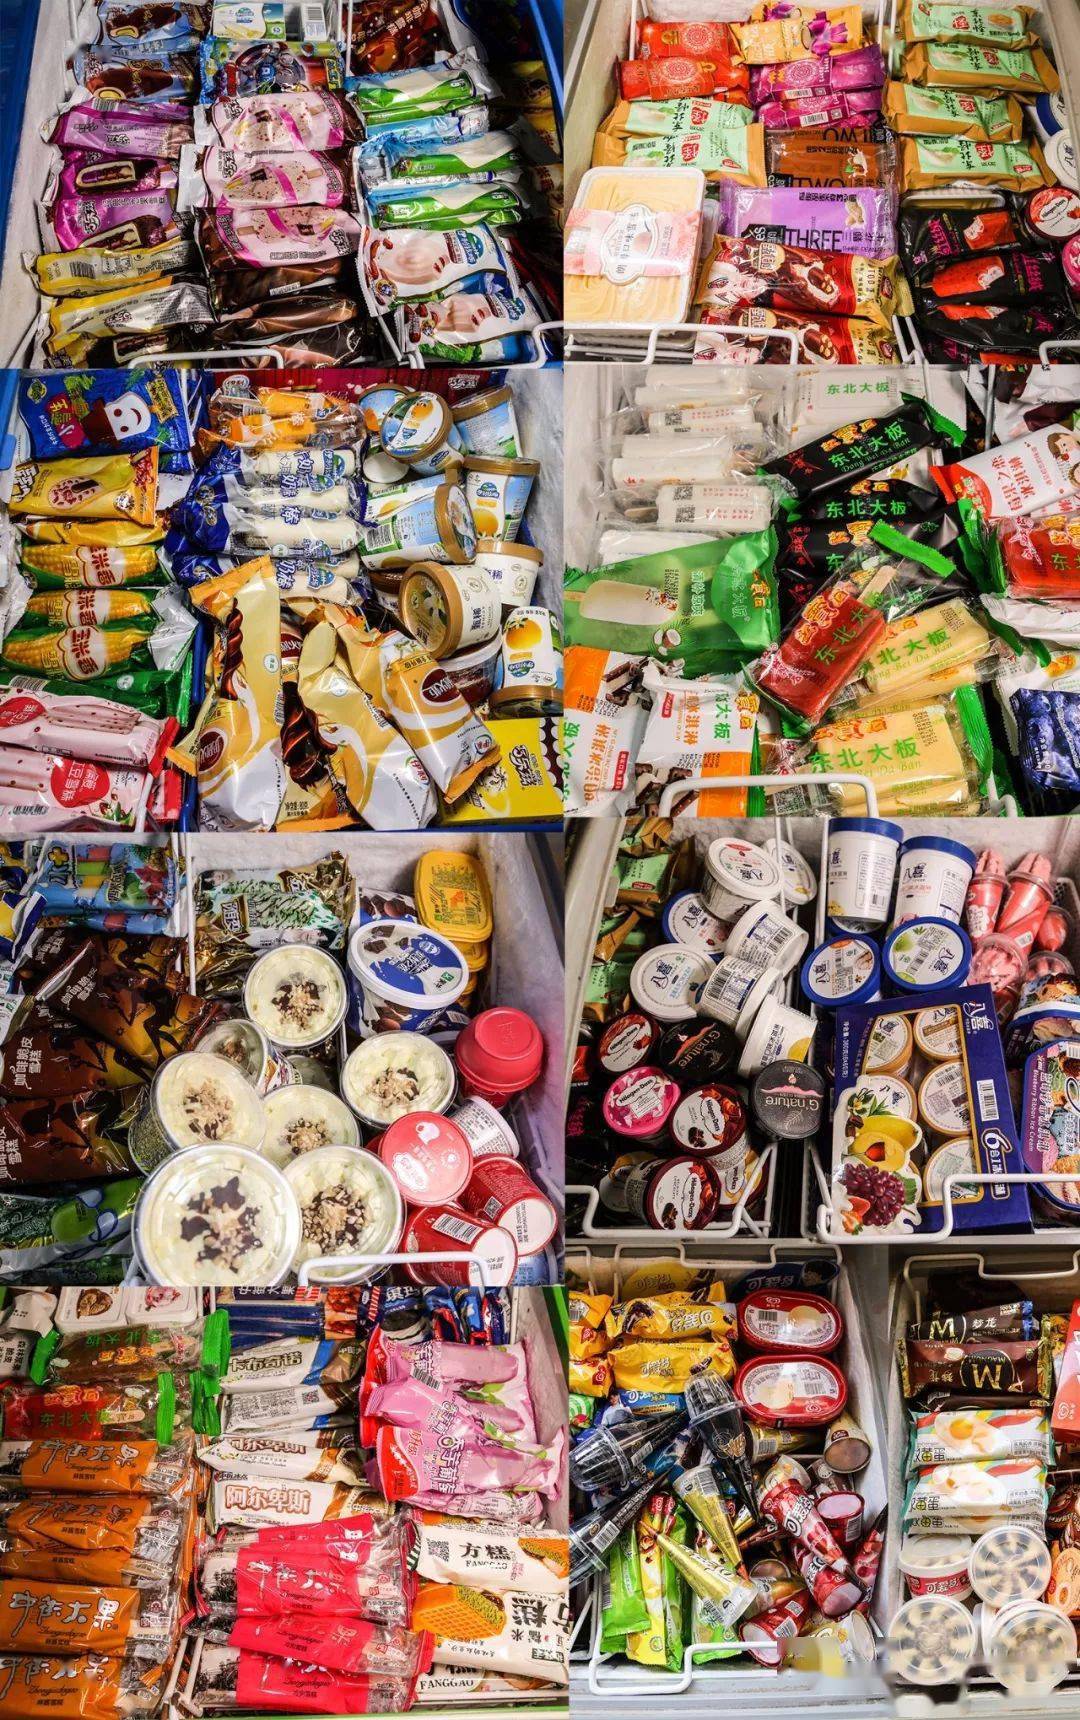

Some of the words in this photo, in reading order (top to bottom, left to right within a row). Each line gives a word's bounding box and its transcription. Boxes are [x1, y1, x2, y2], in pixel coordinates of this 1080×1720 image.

[827, 381, 890, 396] 东北大板
[828, 422, 908, 469] 东北大板
[826, 500, 907, 520] 东北大板
[962, 1001, 995, 1032] 八喜
[14, 1036, 34, 1090] 咖啡脆皮
[28, 1049, 43, 1075] 雪糕
[671, 1310, 716, 1333] 可爱多
[929, 1317, 956, 1340] M
[231, 1350, 303, 1373] 卡布奇诺
[972, 1363, 1002, 1389] M
[225, 1485, 313, 1508] 阿尔卑斯
[460, 1542, 512, 1561] 方糕
[9, 1590, 120, 1638] 中街大果
[419, 1678, 475, 1692] FANGGAO
